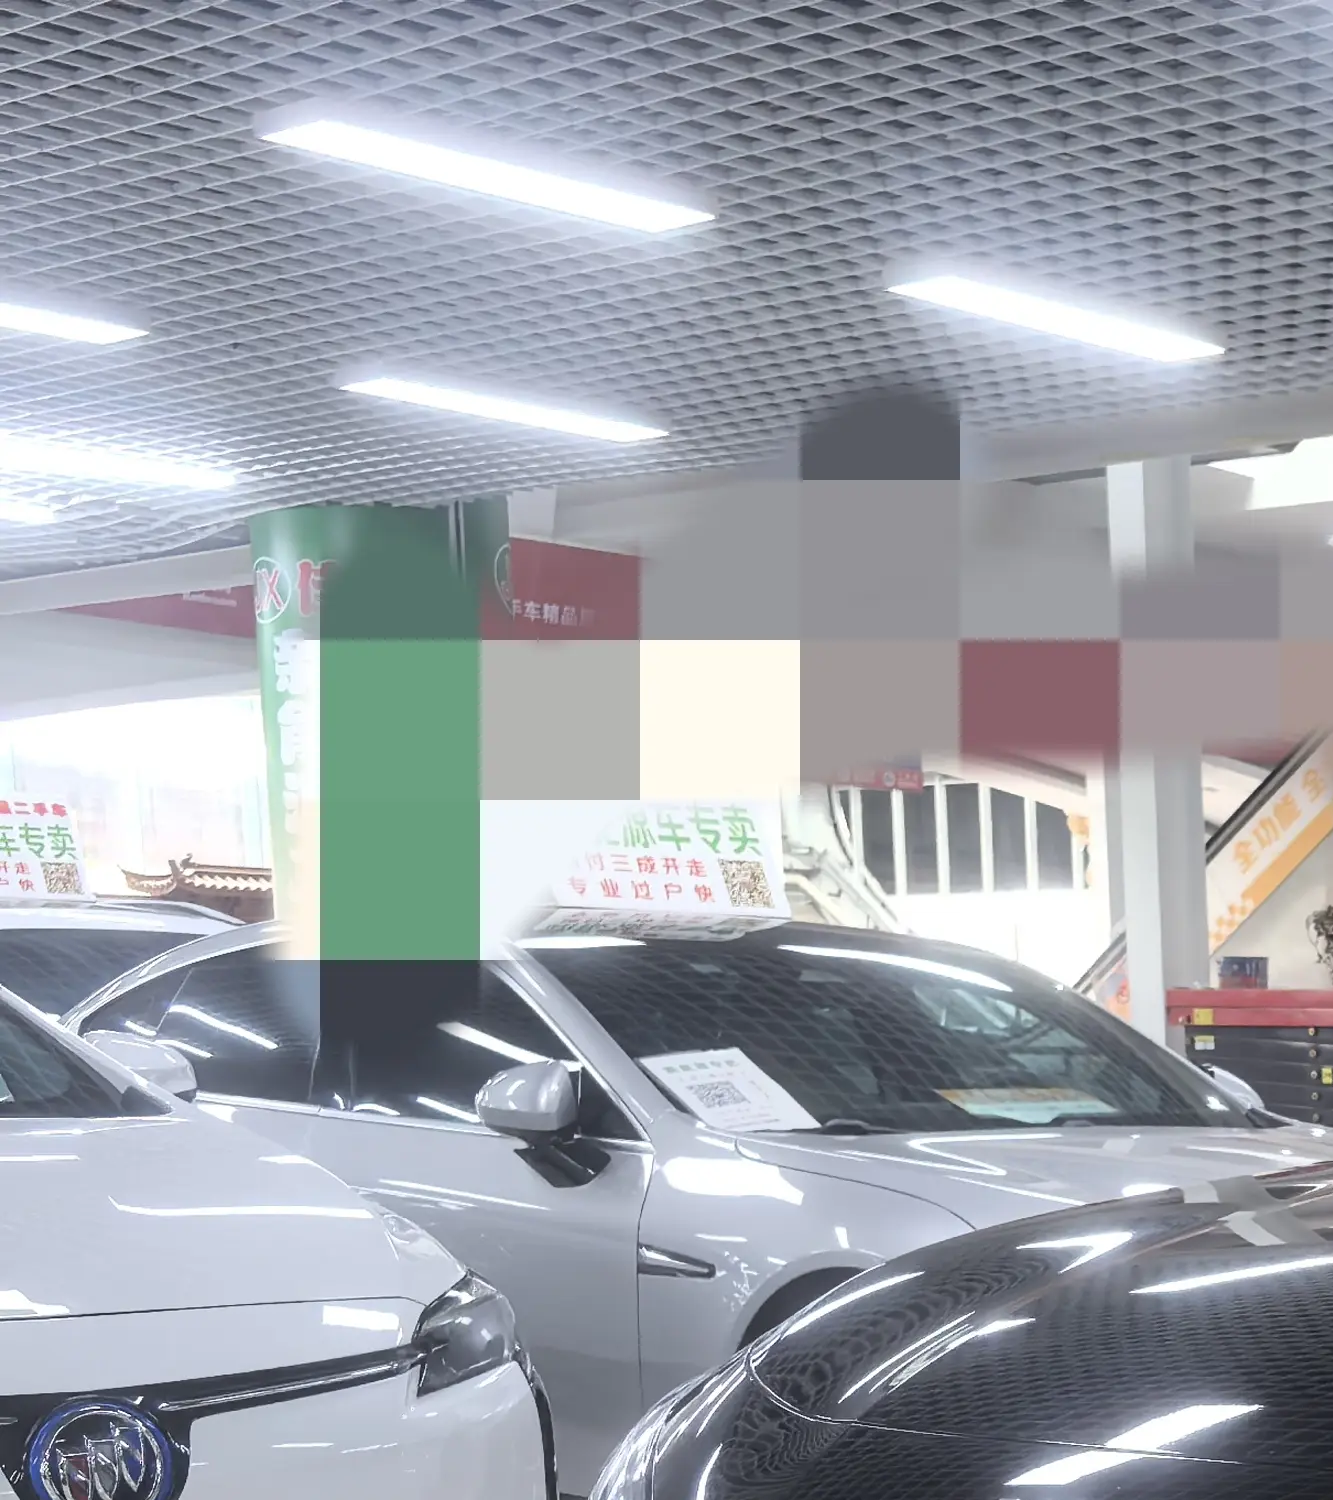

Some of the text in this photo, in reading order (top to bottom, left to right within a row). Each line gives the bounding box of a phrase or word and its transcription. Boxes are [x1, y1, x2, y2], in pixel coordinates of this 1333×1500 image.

[571, 853, 708, 878] 付三成开走
